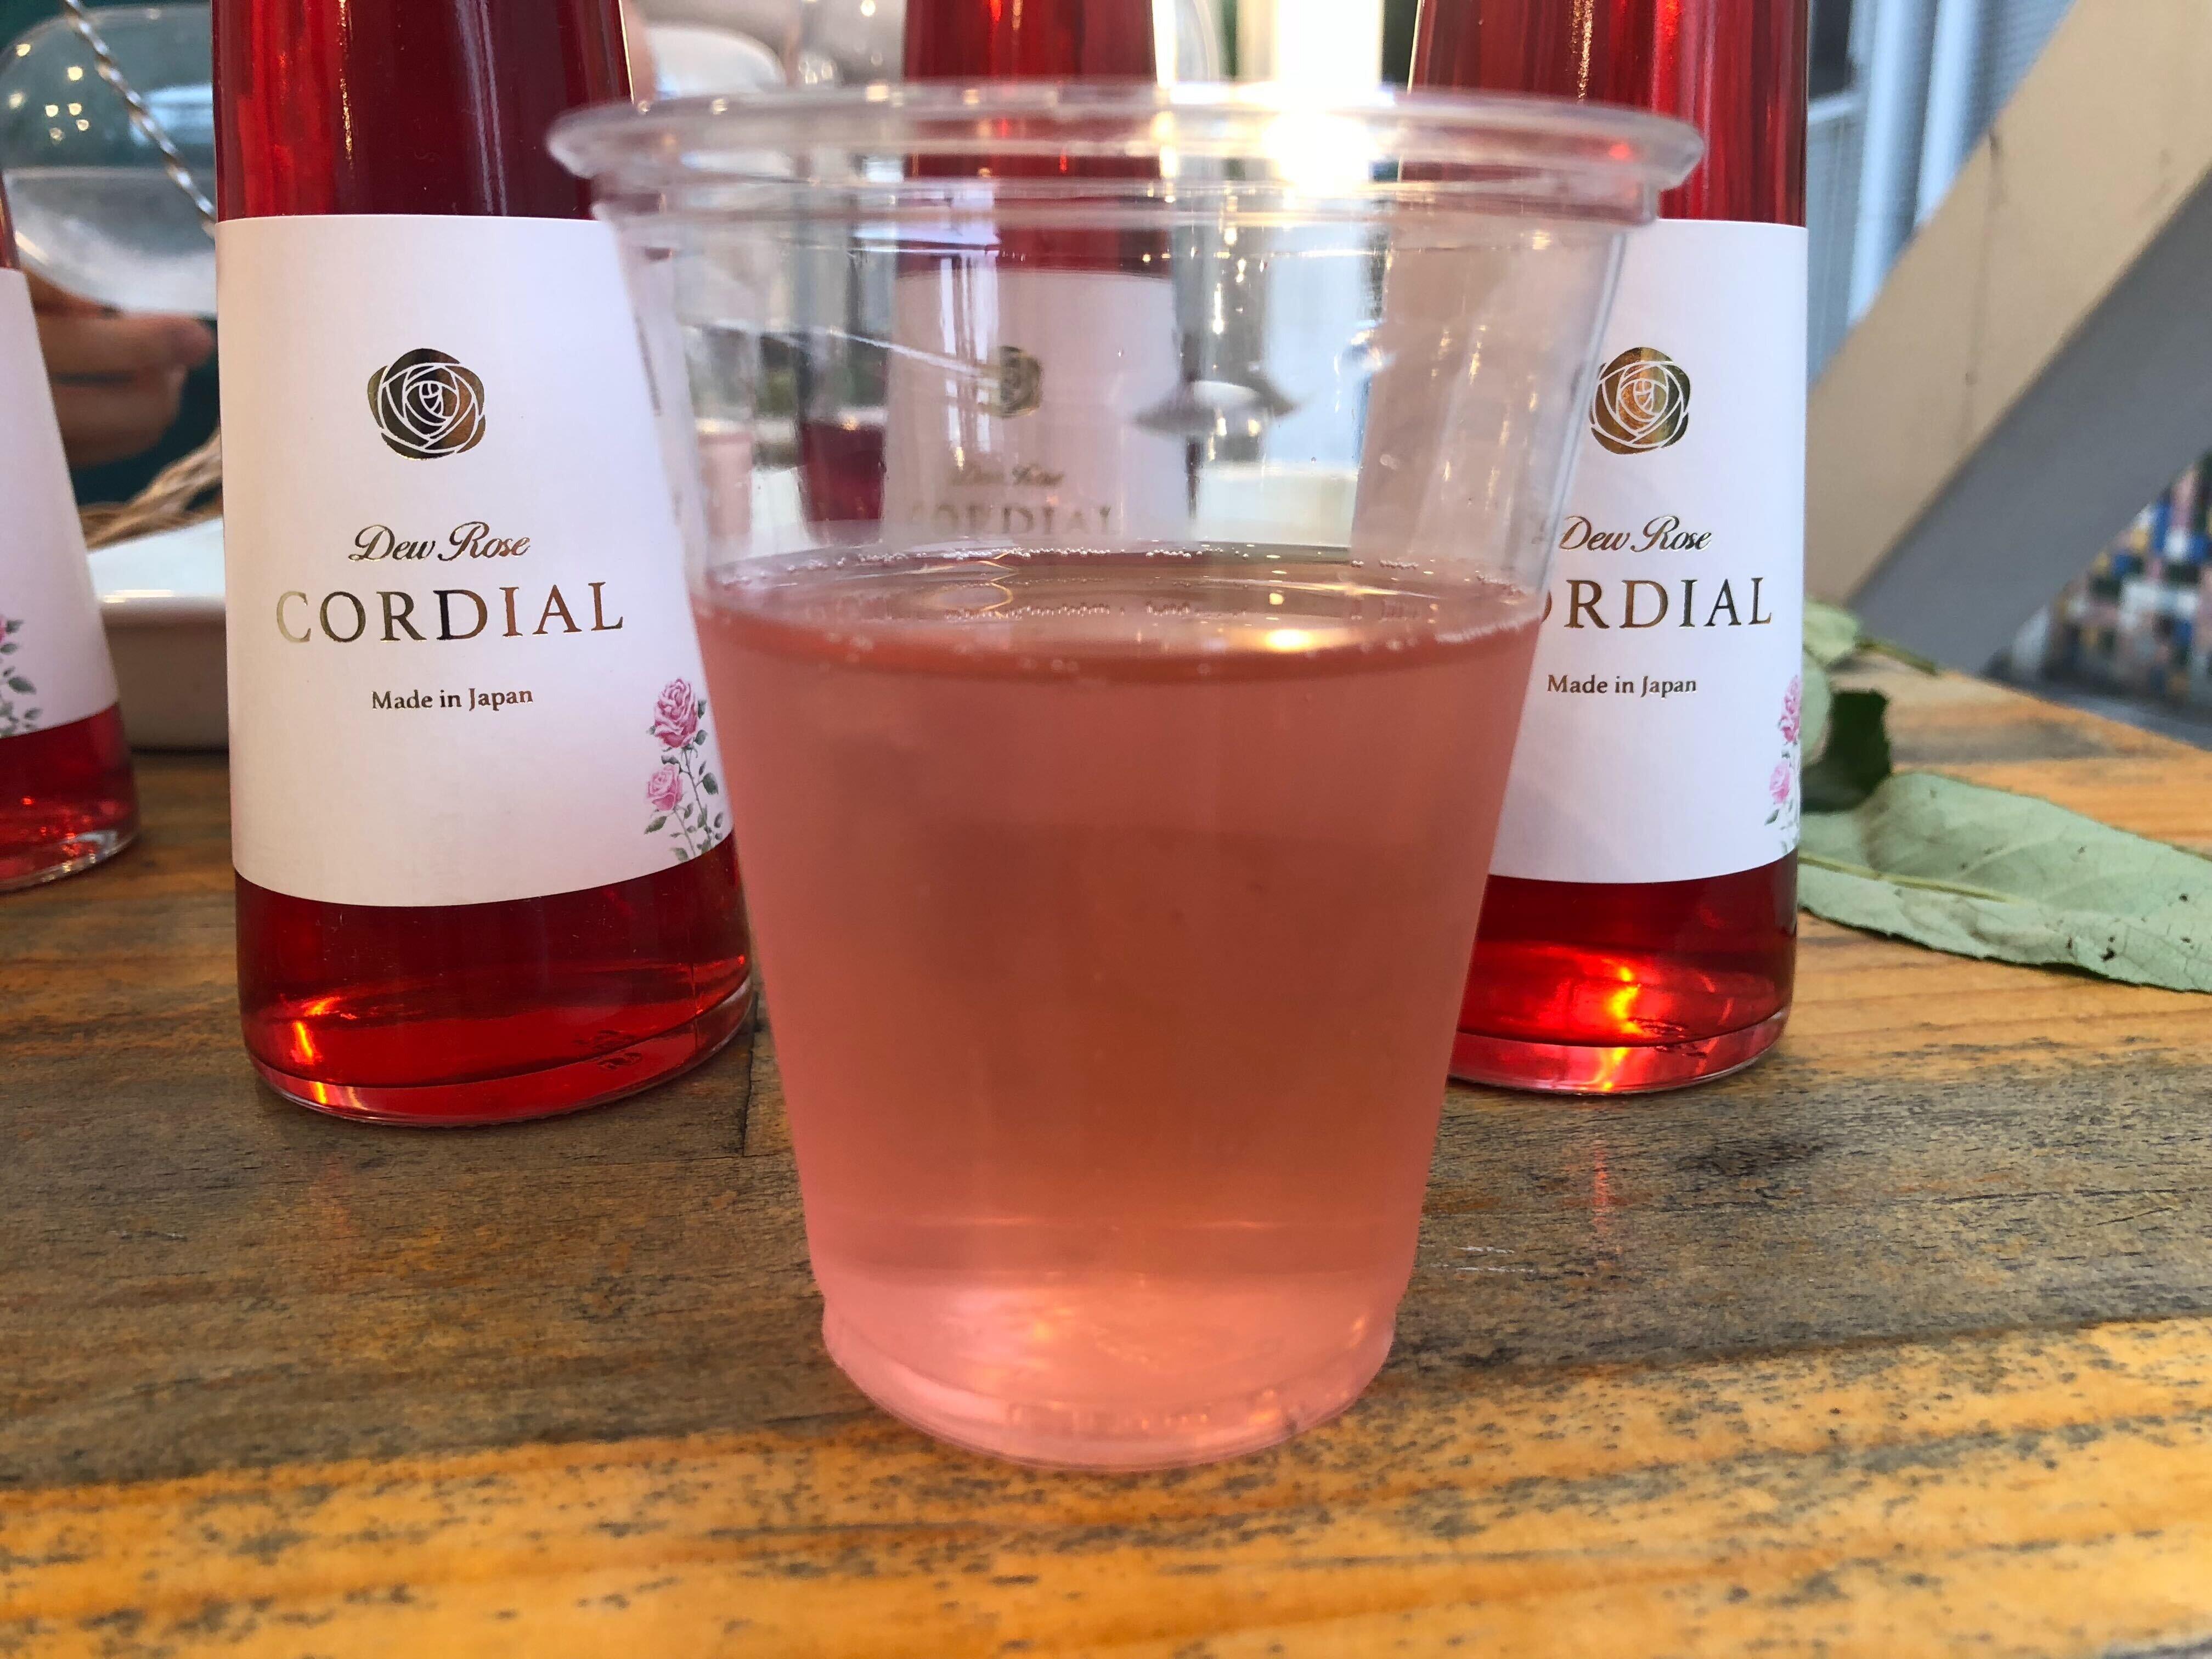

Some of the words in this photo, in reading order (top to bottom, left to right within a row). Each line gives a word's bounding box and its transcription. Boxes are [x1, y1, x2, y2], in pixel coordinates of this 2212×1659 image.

[348, 523, 436, 562] Dew
[437, 520, 531, 562] Rose
[1558, 515, 1630, 551] Dew
[1630, 515, 1712, 552] Rose
[275, 581, 624, 644] CORDIAL
[1542, 577, 1772, 629] RDIAL
[371, 689, 433, 710] Made
[439, 688, 462, 709] in
[469, 687, 534, 712] Japan
[1547, 674, 1609, 695] Made
[1615, 675, 1634, 694] in
[1640, 675, 1697, 699] Japan
